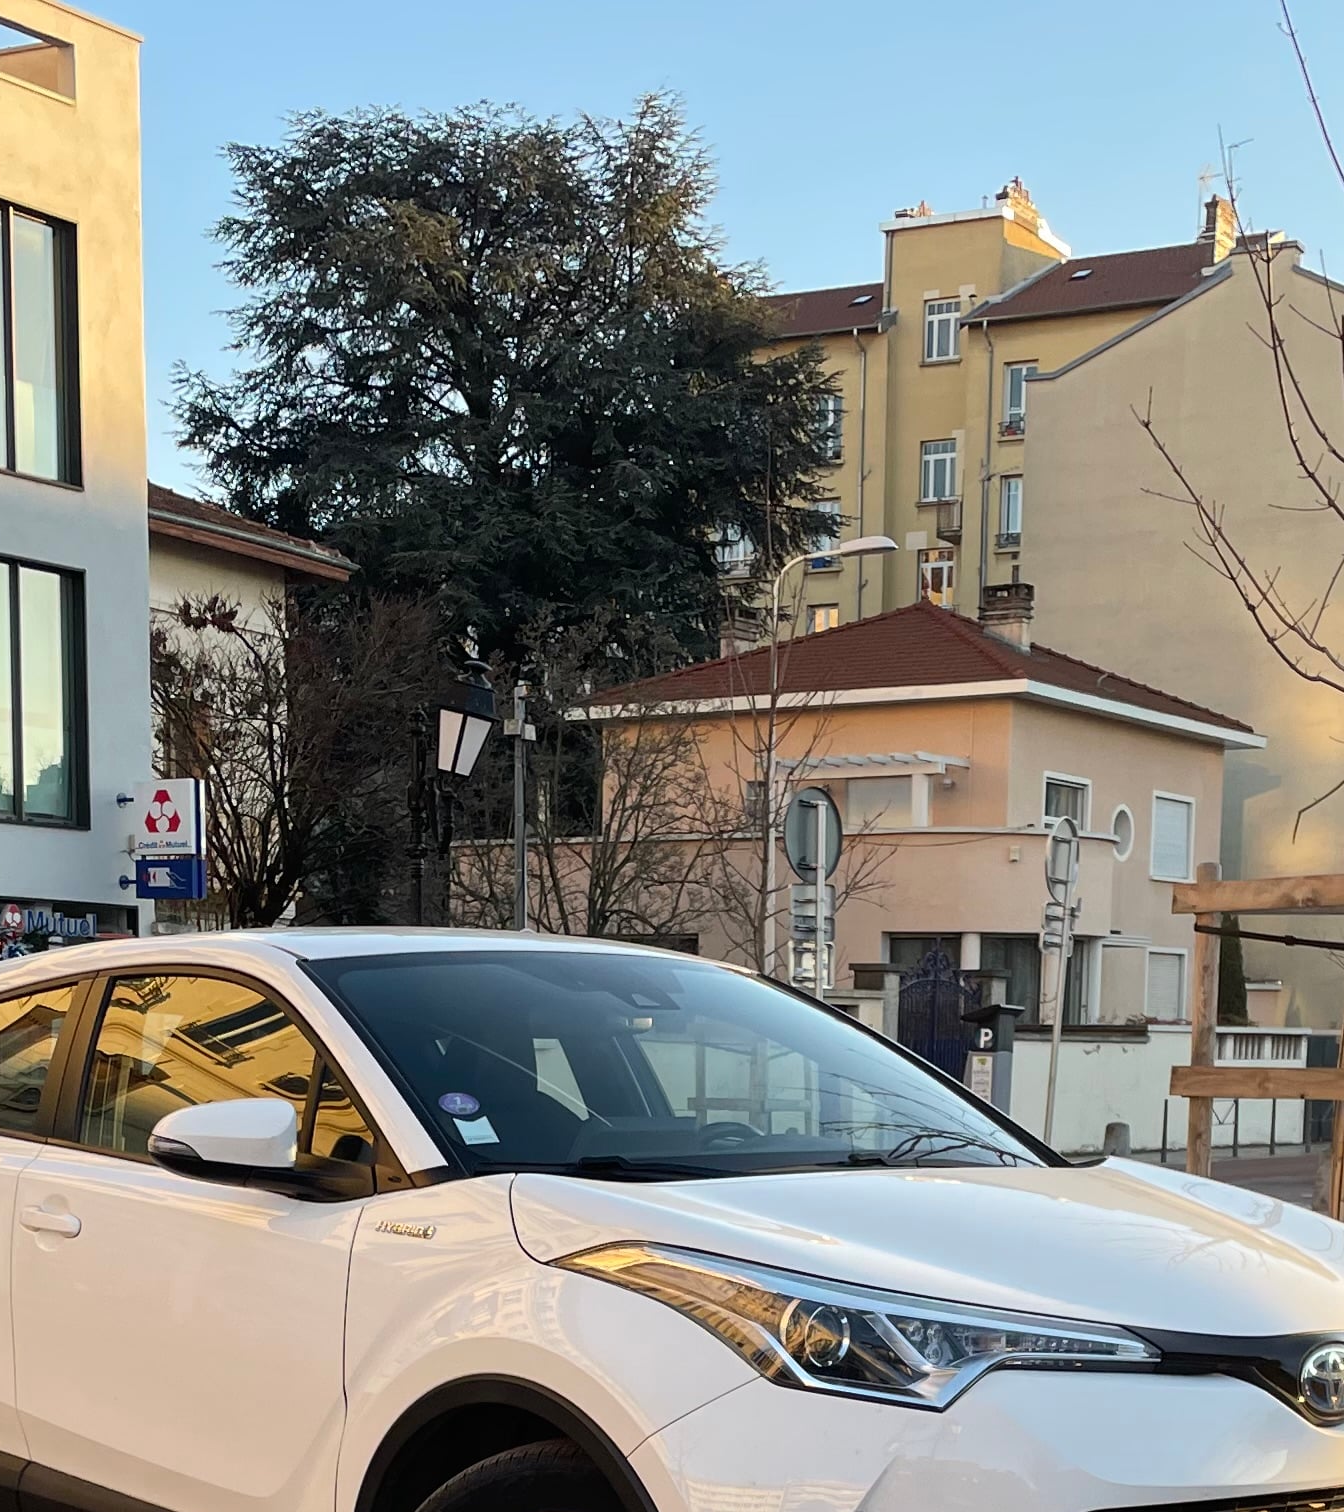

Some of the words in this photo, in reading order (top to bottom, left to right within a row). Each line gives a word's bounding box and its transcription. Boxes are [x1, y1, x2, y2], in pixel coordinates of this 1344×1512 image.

[26, 909, 97, 938] Mutuel
[979, 1027, 994, 1049] P
[375, 1220, 425, 1239] HYBRID
